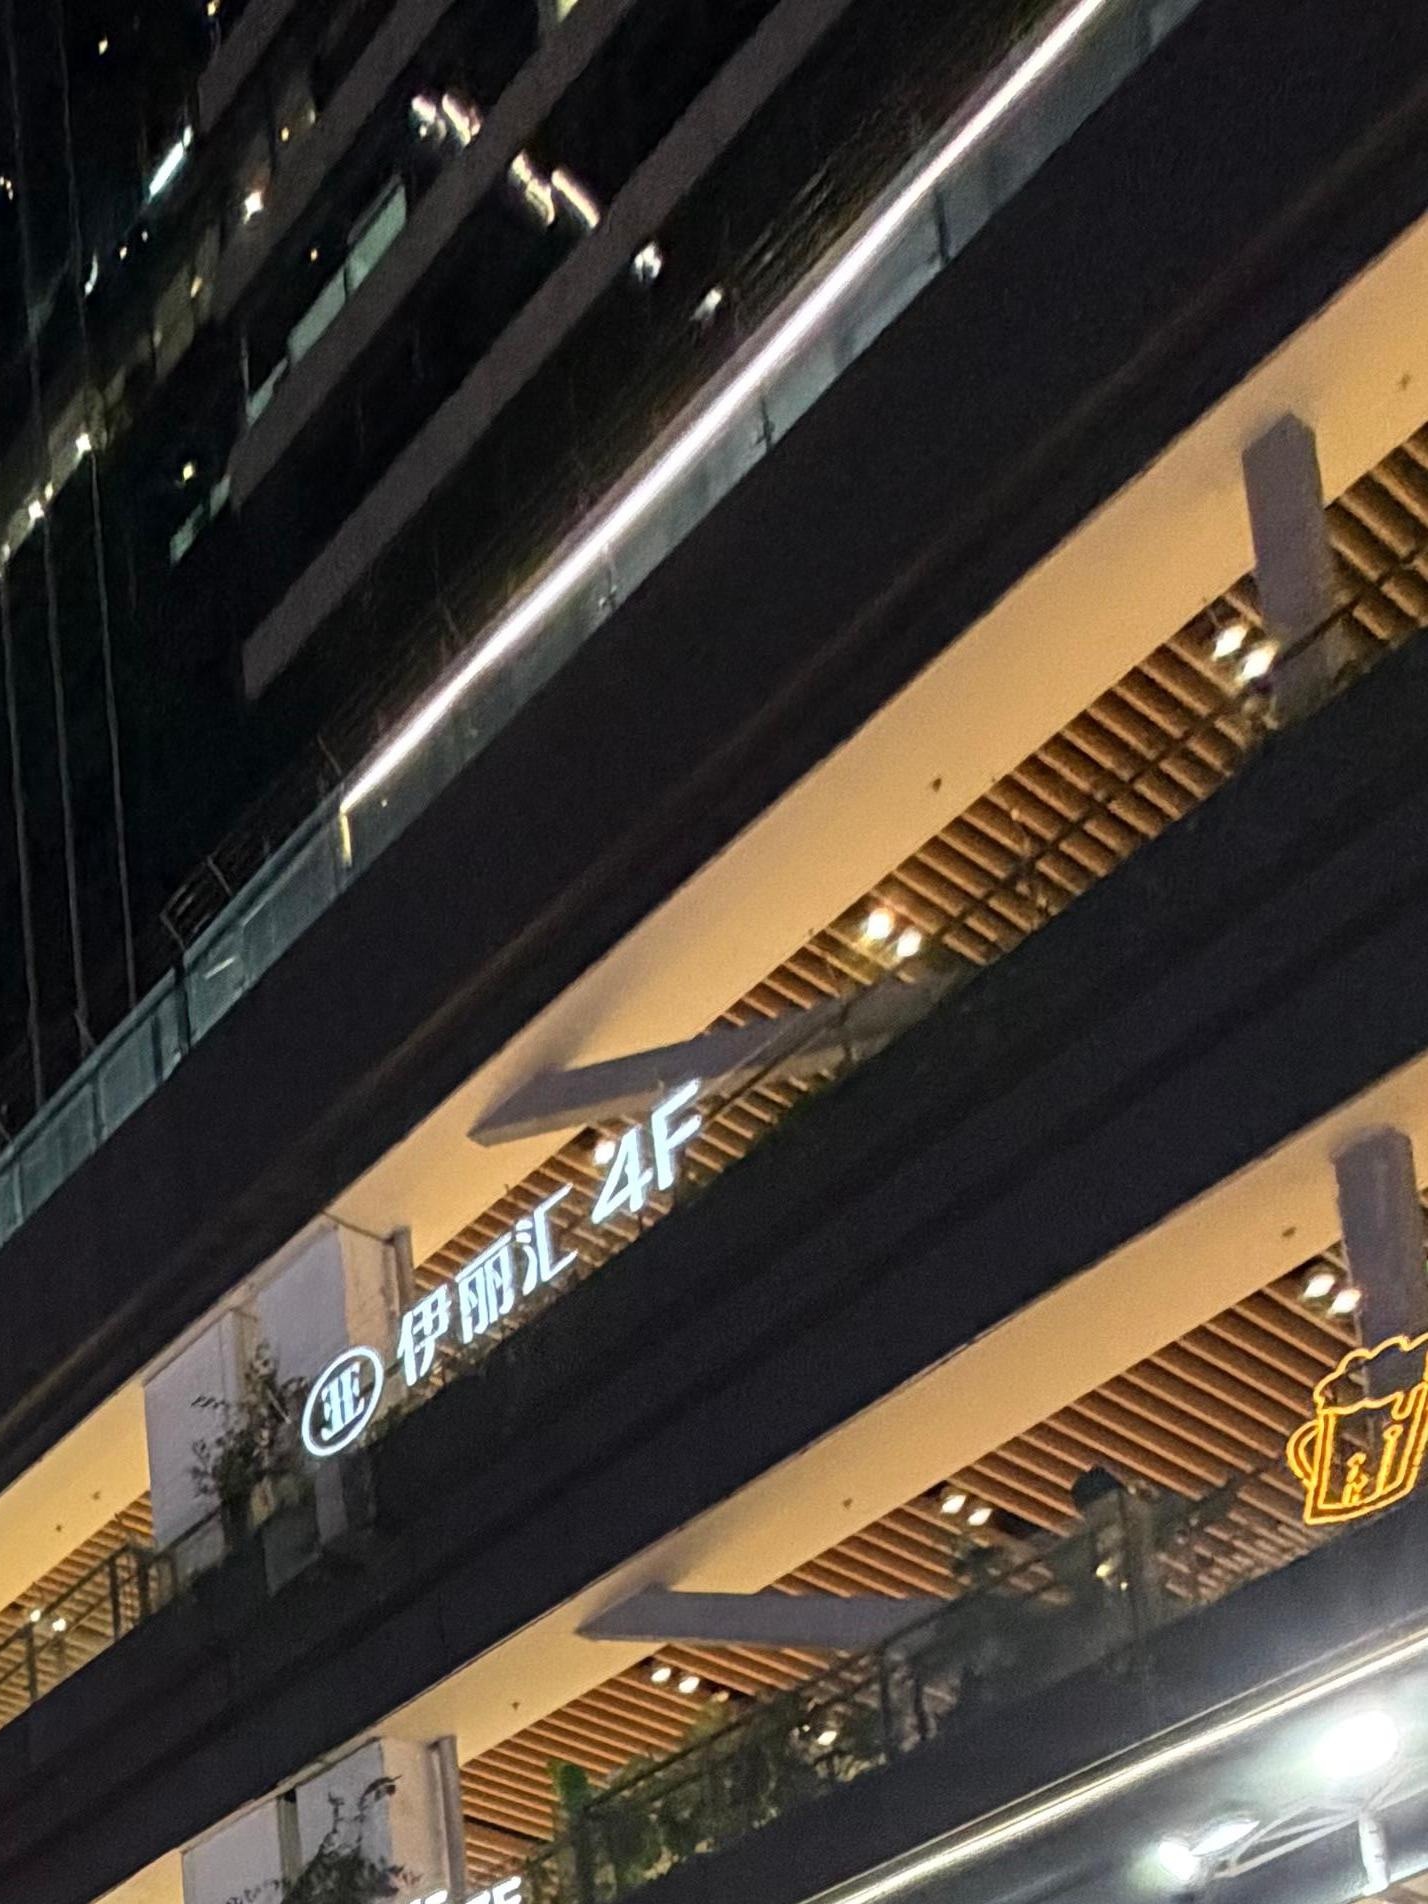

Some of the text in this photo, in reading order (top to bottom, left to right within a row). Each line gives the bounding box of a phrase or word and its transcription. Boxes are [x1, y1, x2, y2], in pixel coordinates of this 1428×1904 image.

[397, 1182, 578, 1387] 伊丽汇
[590, 1078, 702, 1225] 4F
